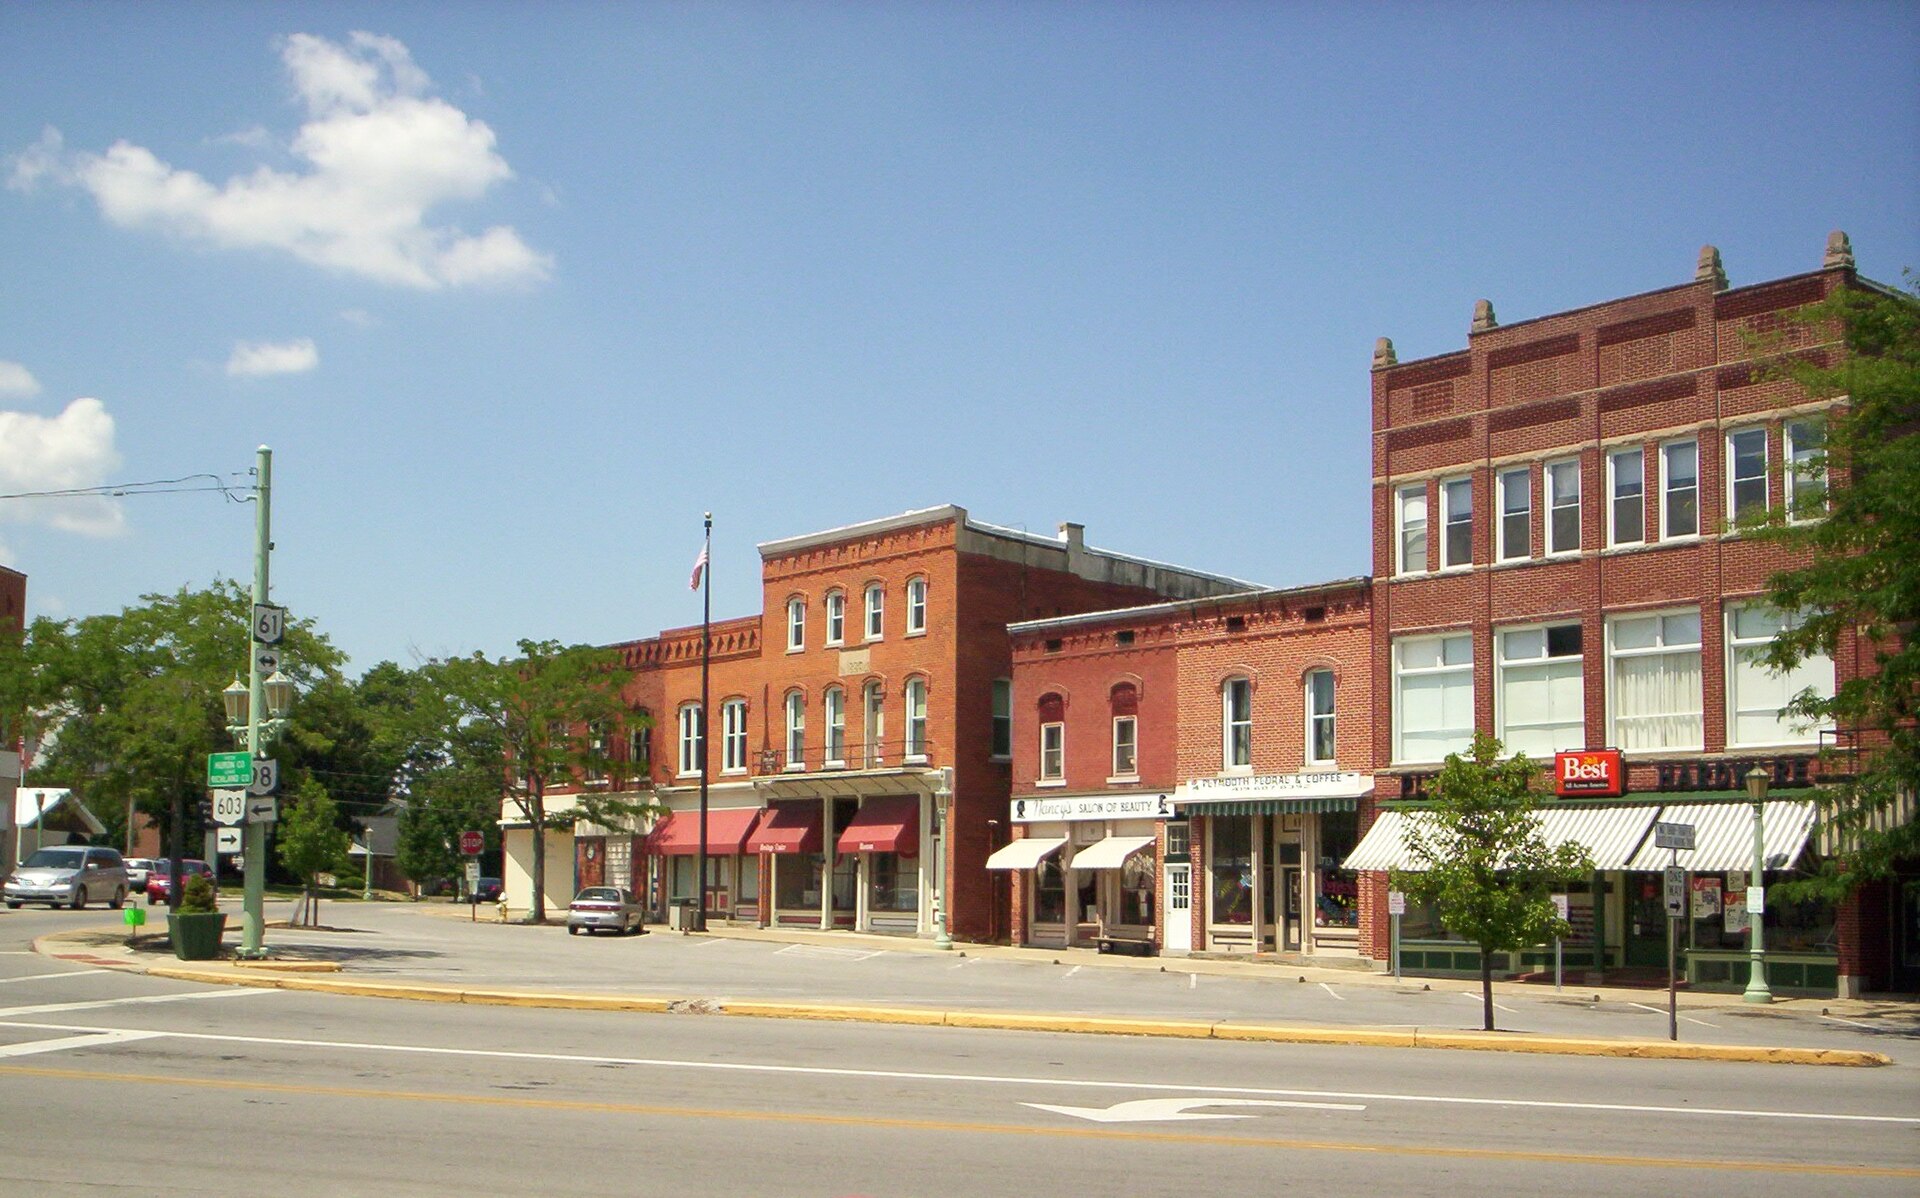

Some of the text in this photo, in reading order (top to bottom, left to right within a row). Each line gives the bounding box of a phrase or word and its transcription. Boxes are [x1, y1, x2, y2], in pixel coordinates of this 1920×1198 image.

[259, 614, 277, 634] 61
[1563, 757, 1609, 779] Best
[1660, 759, 1808, 790] HARDWRE
[1202, 778, 1249, 788] PLYMOUTH
[1254, 775, 1289, 785] FLORAL
[1306, 773, 1342, 783] COFFEE
[217, 797, 241, 815] 603
[1078, 802, 1104, 813] SALON
[1106, 802, 1117, 813] OF
[1120, 800, 1152, 812] BEAUTY
[463, 838, 482, 848] STOP
